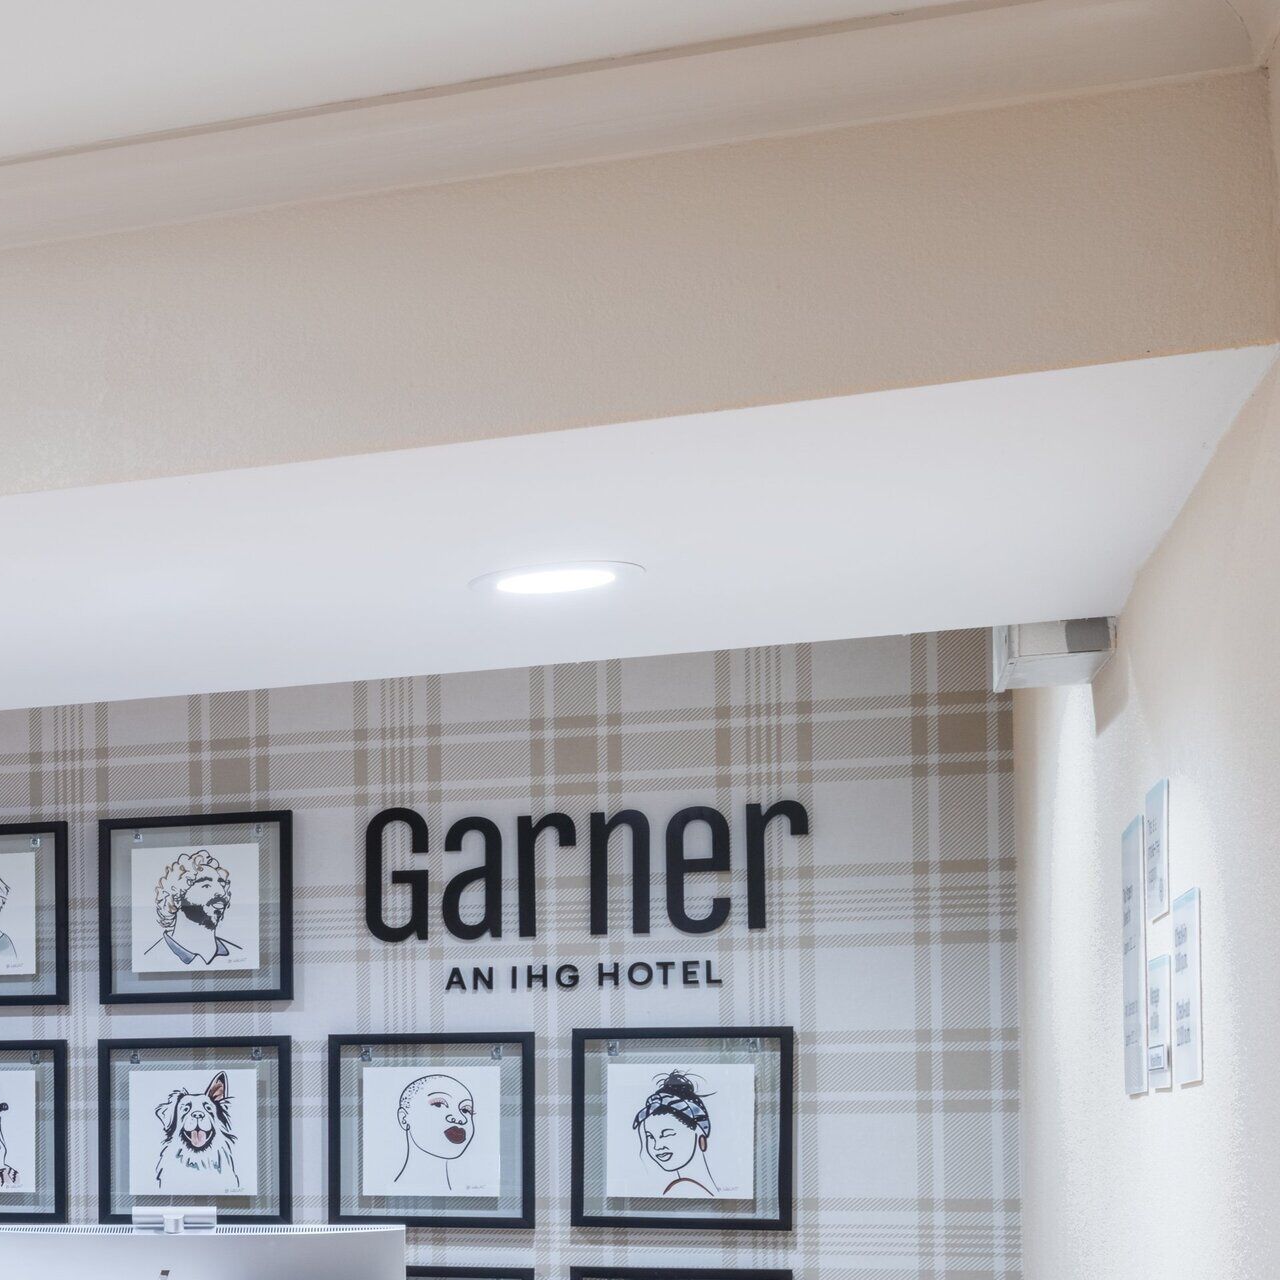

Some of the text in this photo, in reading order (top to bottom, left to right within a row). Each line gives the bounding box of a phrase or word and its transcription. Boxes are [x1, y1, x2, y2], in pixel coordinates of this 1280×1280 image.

[365, 799, 809, 943] Garner
[444, 960, 724, 992] AN IHG HOTEL
